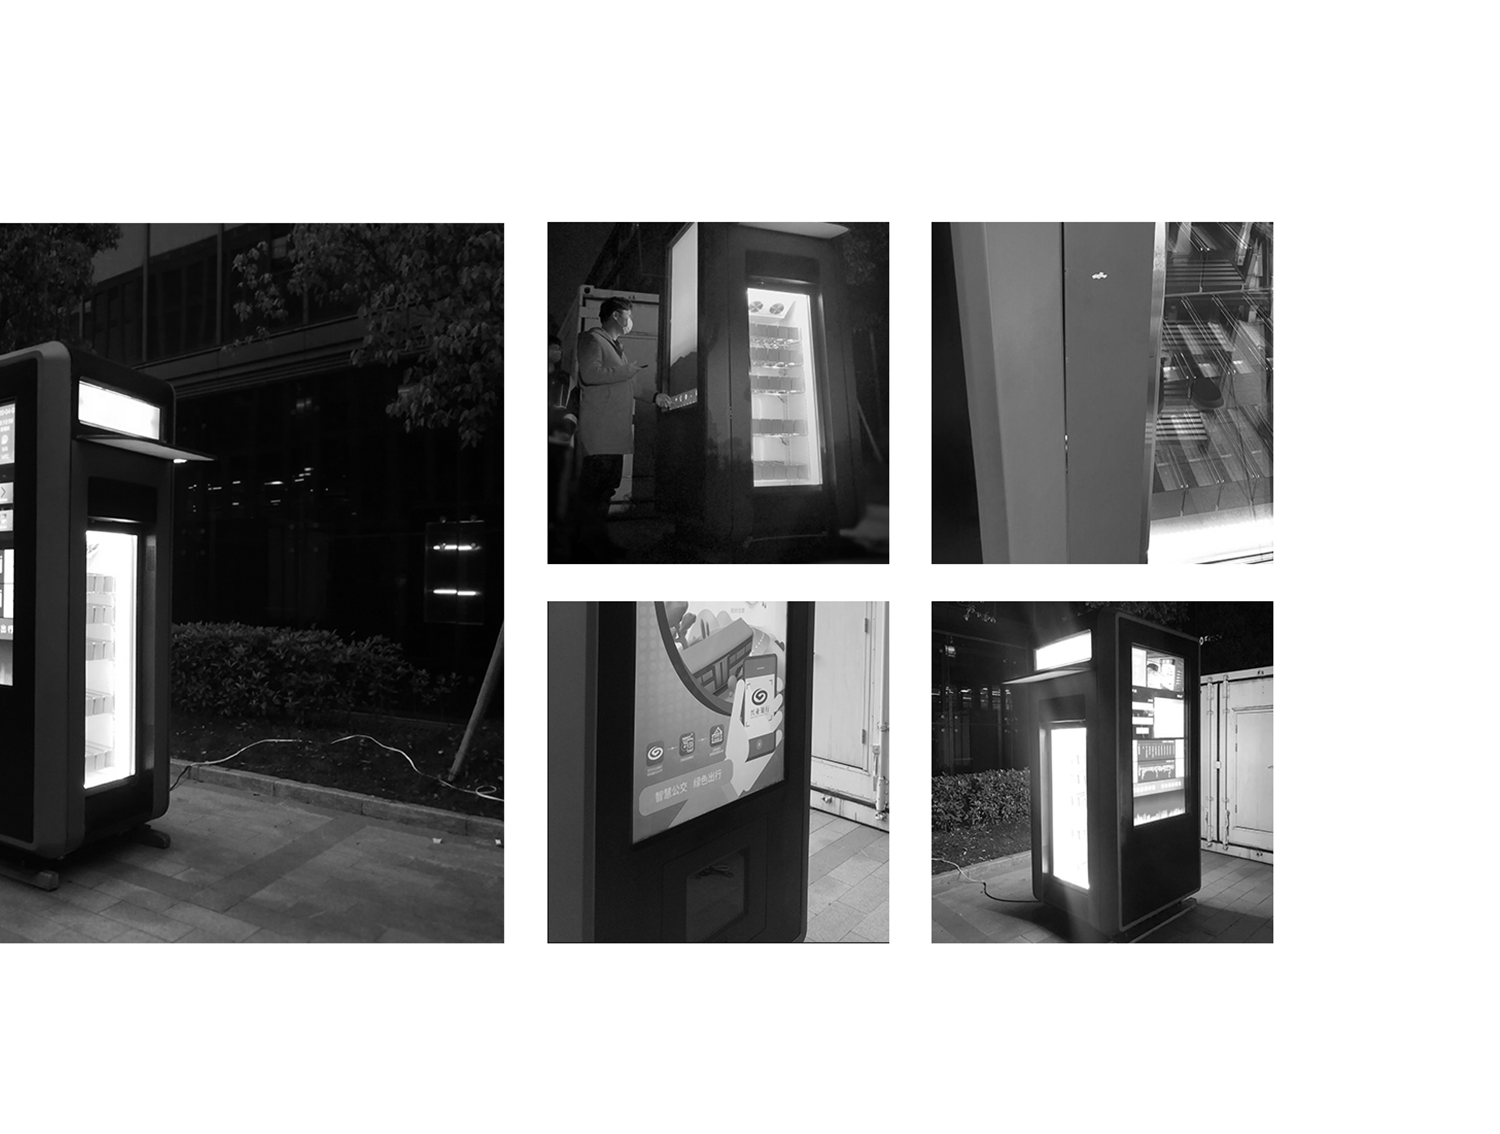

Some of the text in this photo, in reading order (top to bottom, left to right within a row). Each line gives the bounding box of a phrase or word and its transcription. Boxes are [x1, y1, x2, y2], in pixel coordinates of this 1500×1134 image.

[654, 769, 722, 803] 智慧公交 绿色出行
